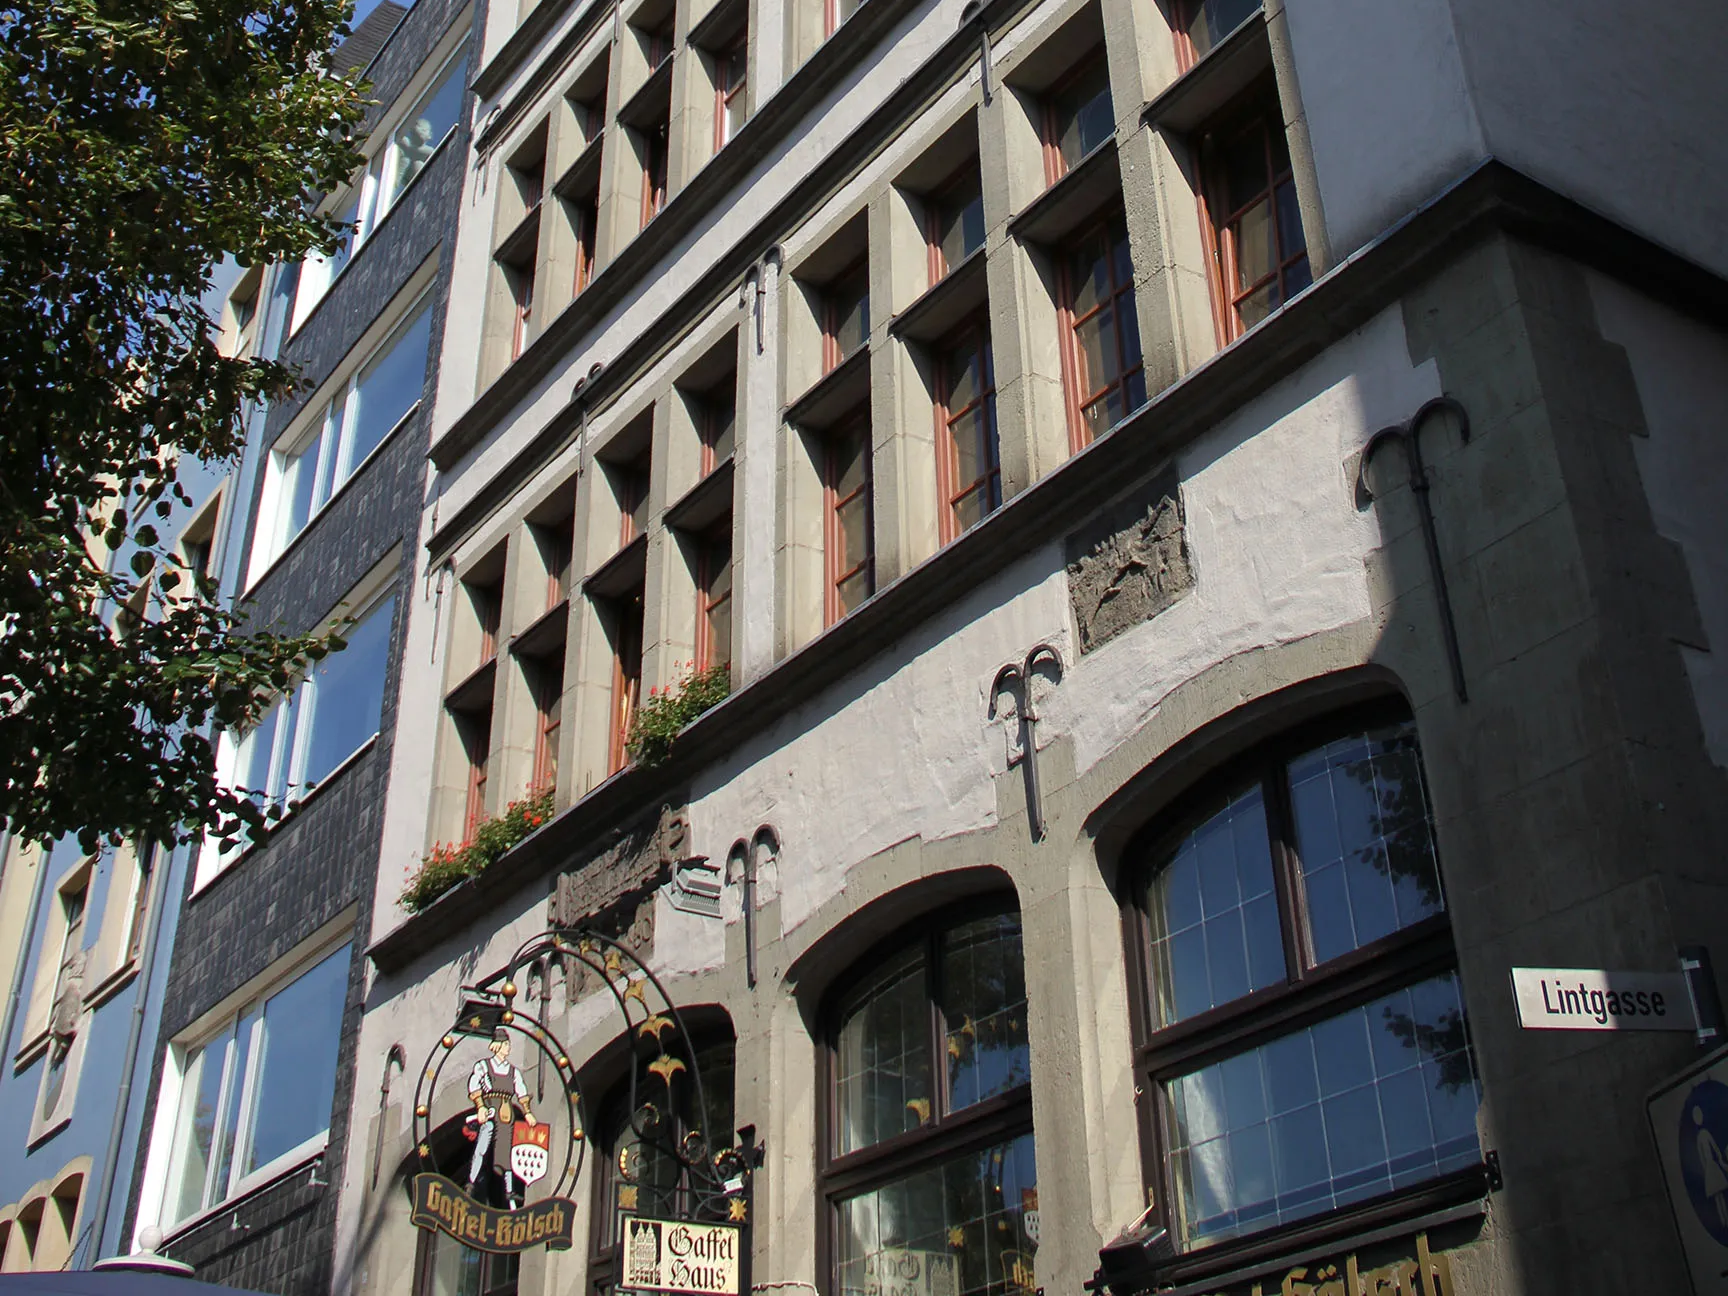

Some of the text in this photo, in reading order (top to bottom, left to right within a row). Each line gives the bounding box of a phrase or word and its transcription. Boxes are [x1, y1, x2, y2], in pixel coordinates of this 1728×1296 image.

[1541, 979, 1666, 1024] Lintgasse
[426, 1180, 565, 1247] Gaffel-Kölsch
[668, 1223, 735, 1263] Gaffel
[668, 1258, 727, 1290] Haus
